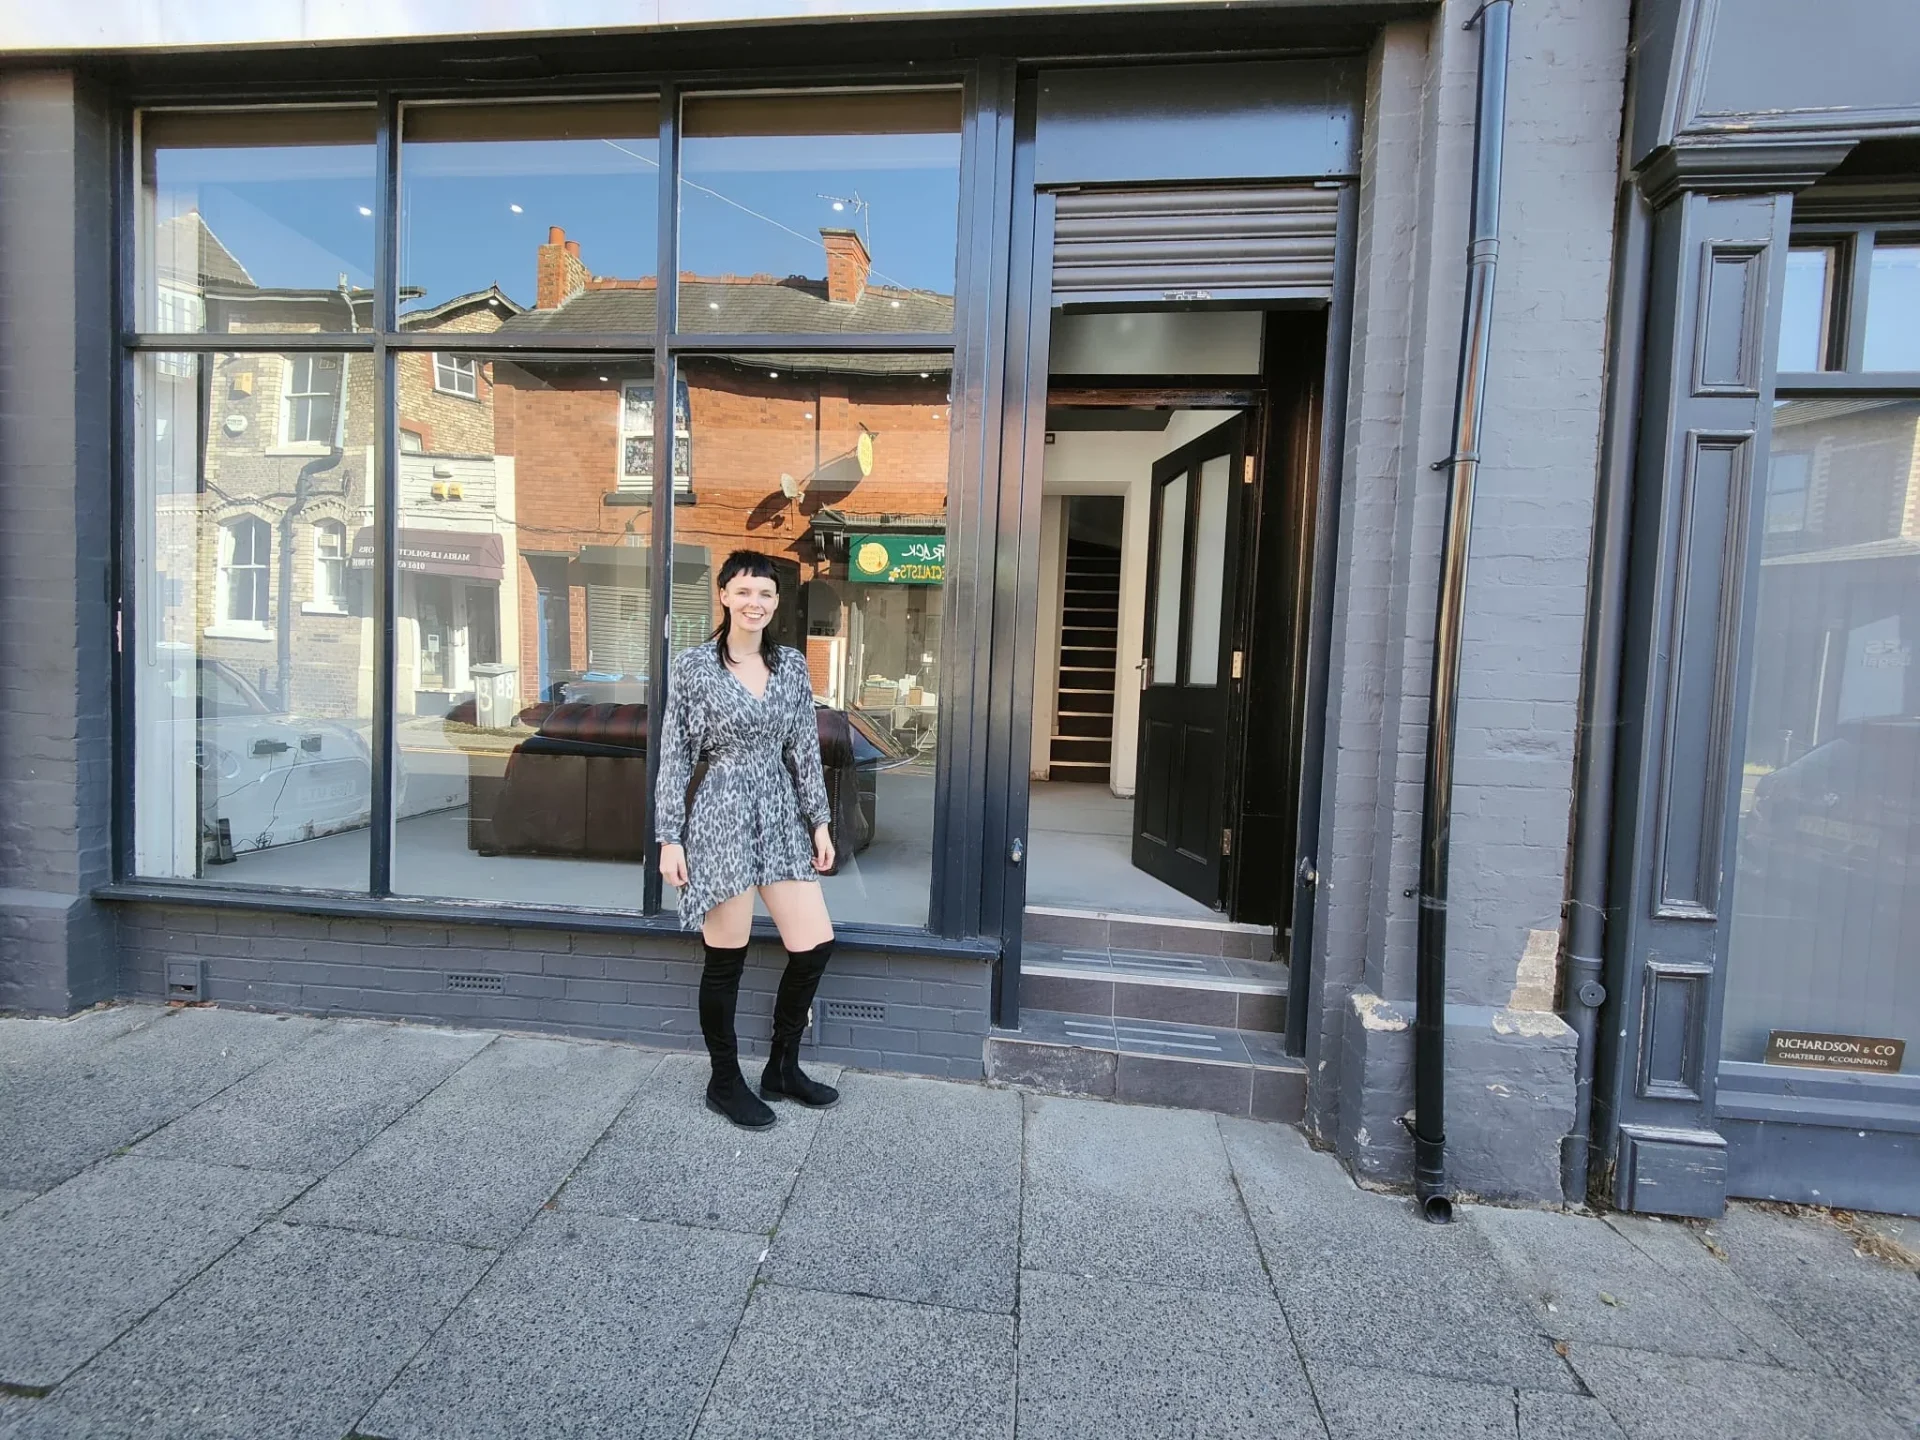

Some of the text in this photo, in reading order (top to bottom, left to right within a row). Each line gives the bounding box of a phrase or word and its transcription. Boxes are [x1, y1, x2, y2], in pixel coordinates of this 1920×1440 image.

[1775, 1037, 1861, 1053] RICHARDSON
[1874, 1045, 1896, 1056] CO
[1778, 1052, 1889, 1066] CHARTERED ACCOUNTANTS
